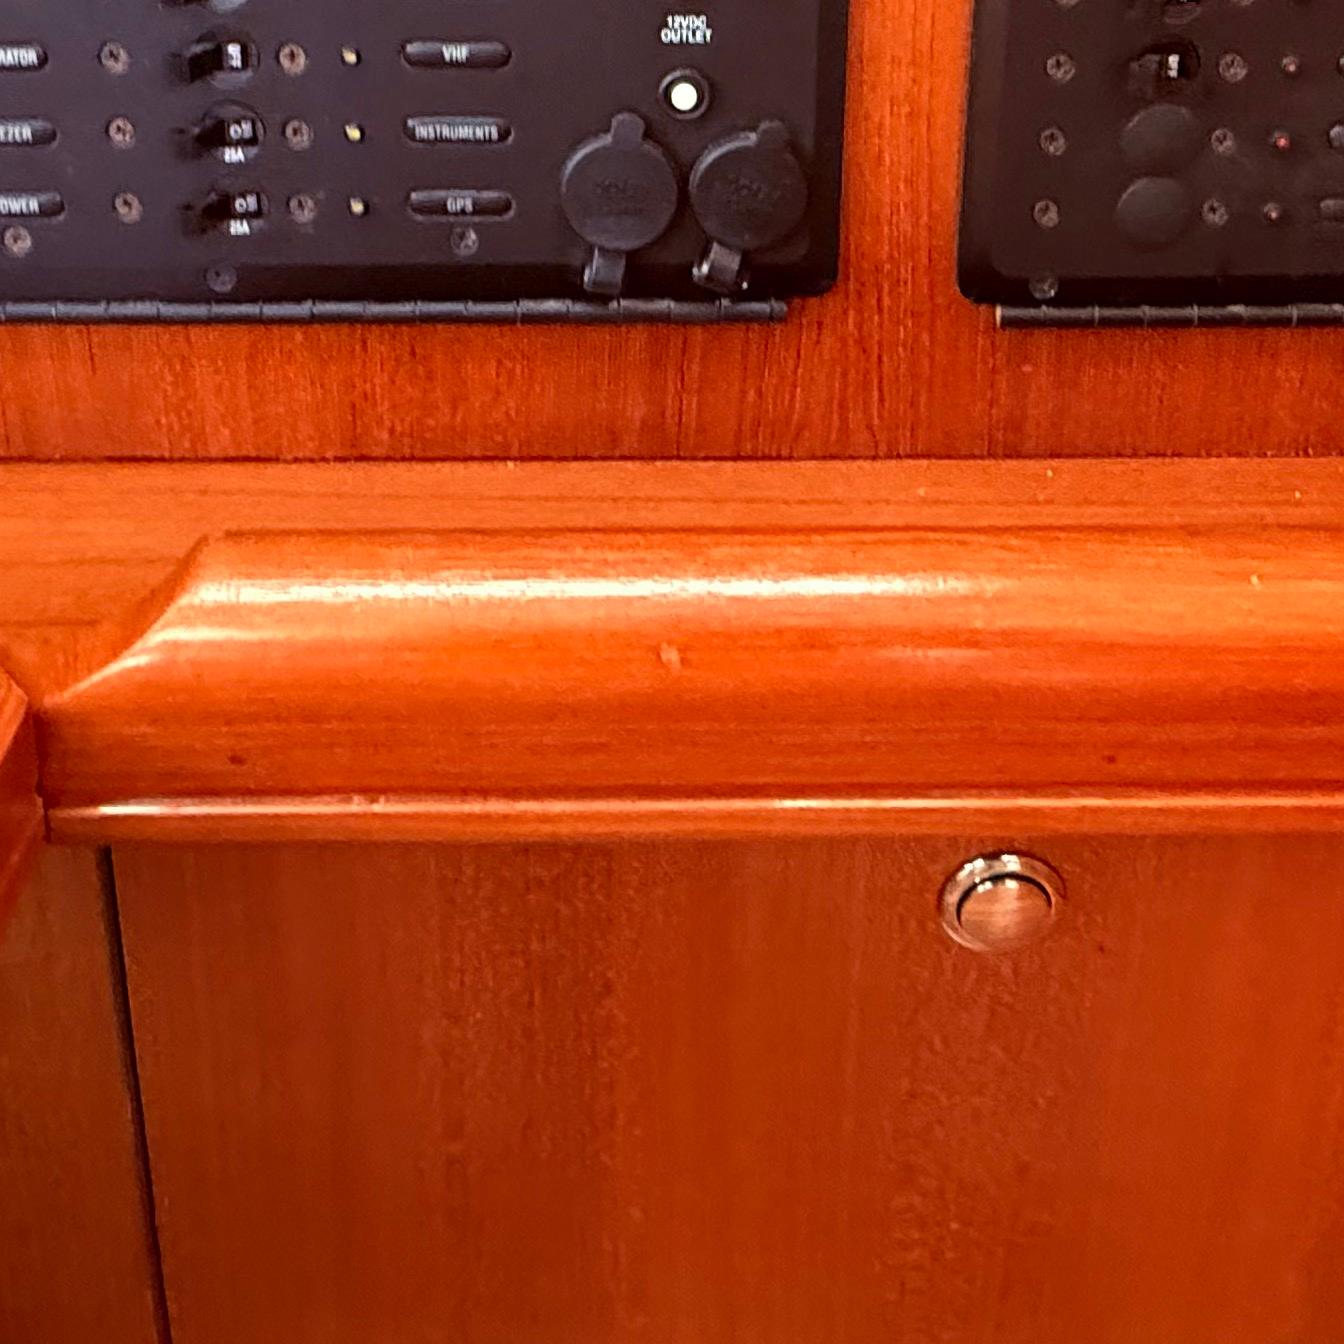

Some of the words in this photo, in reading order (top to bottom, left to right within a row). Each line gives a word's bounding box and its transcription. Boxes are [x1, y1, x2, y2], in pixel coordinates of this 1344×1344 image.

[666, 16, 706, 29] 12VDC
[661, 28, 712, 44] OUTLET
[442, 44, 470, 63] VHF
[415, 125, 498, 141] INSTRUMENTS
[447, 197, 473, 213] GPS
